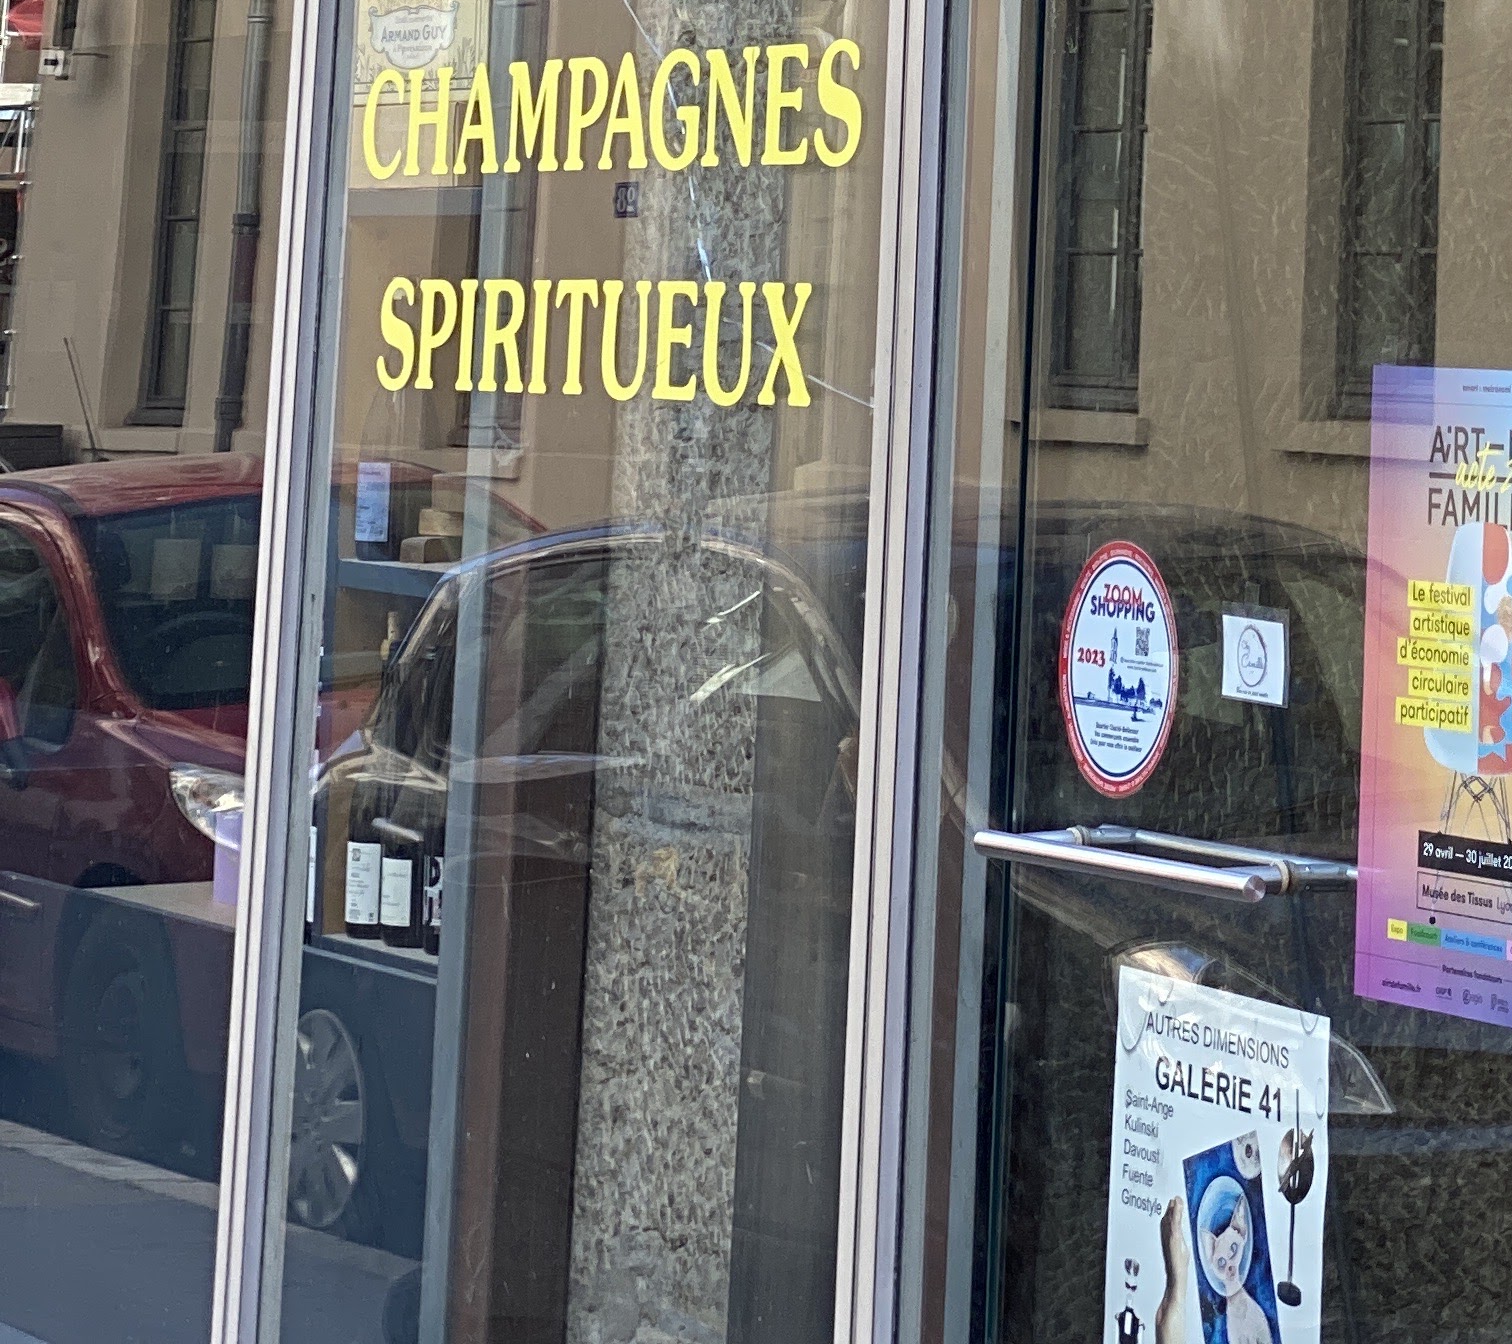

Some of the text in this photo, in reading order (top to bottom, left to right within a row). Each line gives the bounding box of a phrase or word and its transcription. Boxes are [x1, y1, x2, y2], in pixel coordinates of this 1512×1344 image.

[381, 23, 448, 43] ARMAND GUY
[363, 38, 862, 180] CHAMPAGNES
[376, 276, 812, 408] SPIRITUEUX
[1103, 583, 1143, 605] ZOOM
[1412, 582, 1471, 606] Le festival
[1090, 594, 1156, 623] SHOPPING
[1412, 613, 1470, 640] artistique
[1077, 647, 1106, 668] 2023
[1400, 637, 1470, 666] d'économie
[1411, 670, 1469, 697] circulaire
[1399, 702, 1469, 728] participatif
[1423, 842, 1434, 856] 29
[1435, 846, 1453, 859] avril
[1465, 849, 1477, 863] 30
[1478, 851, 1501, 868] juillet
[1422, 883, 1449, 900] Musée
[1450, 889, 1466, 904] des
[1467, 891, 1493, 909] Tissus
[1146, 1011, 1290, 1069] AUTRES DIMENSIONS
[1125, 1090, 1174, 1118] Saint-Ange
[1258, 1082, 1283, 1122] 41
[1124, 1114, 1160, 1139] Kulinski
[1123, 1139, 1160, 1163] Davoust
[1122, 1164, 1153, 1188] Fuente
[1121, 1188, 1162, 1217] Ginostyle
